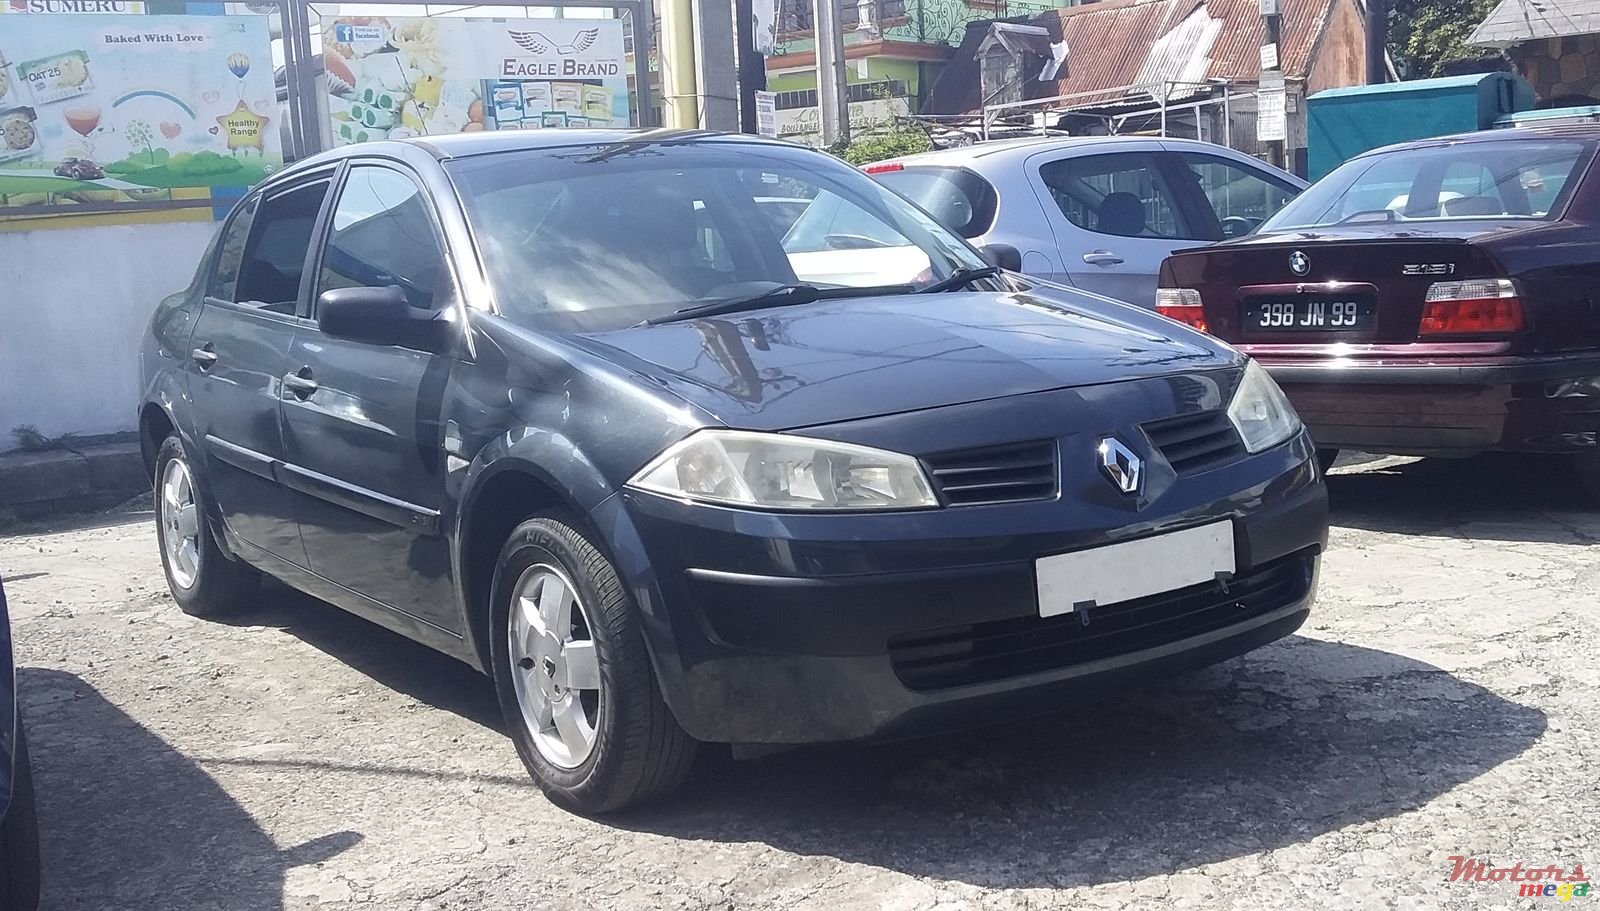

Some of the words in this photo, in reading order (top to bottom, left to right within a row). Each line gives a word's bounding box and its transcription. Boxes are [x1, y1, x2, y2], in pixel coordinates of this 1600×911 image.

[30, 0, 126, 13] SUMERU
[105, 34, 141, 43] Baked
[144, 34, 173, 43] With
[176, 33, 204, 42] Love
[503, 58, 557, 76] EAGLE
[563, 58, 618, 76] BRAND
[28, 70, 47, 82] OAT
[47, 66, 61, 78] 25
[227, 119, 260, 128] Healthy
[781, 122, 819, 134] BOULANGE
[230, 128, 258, 136] Range
[1260, 303, 1294, 326] 398
[1300, 302, 1325, 326] JN
[1331, 302, 1357, 326] 99
